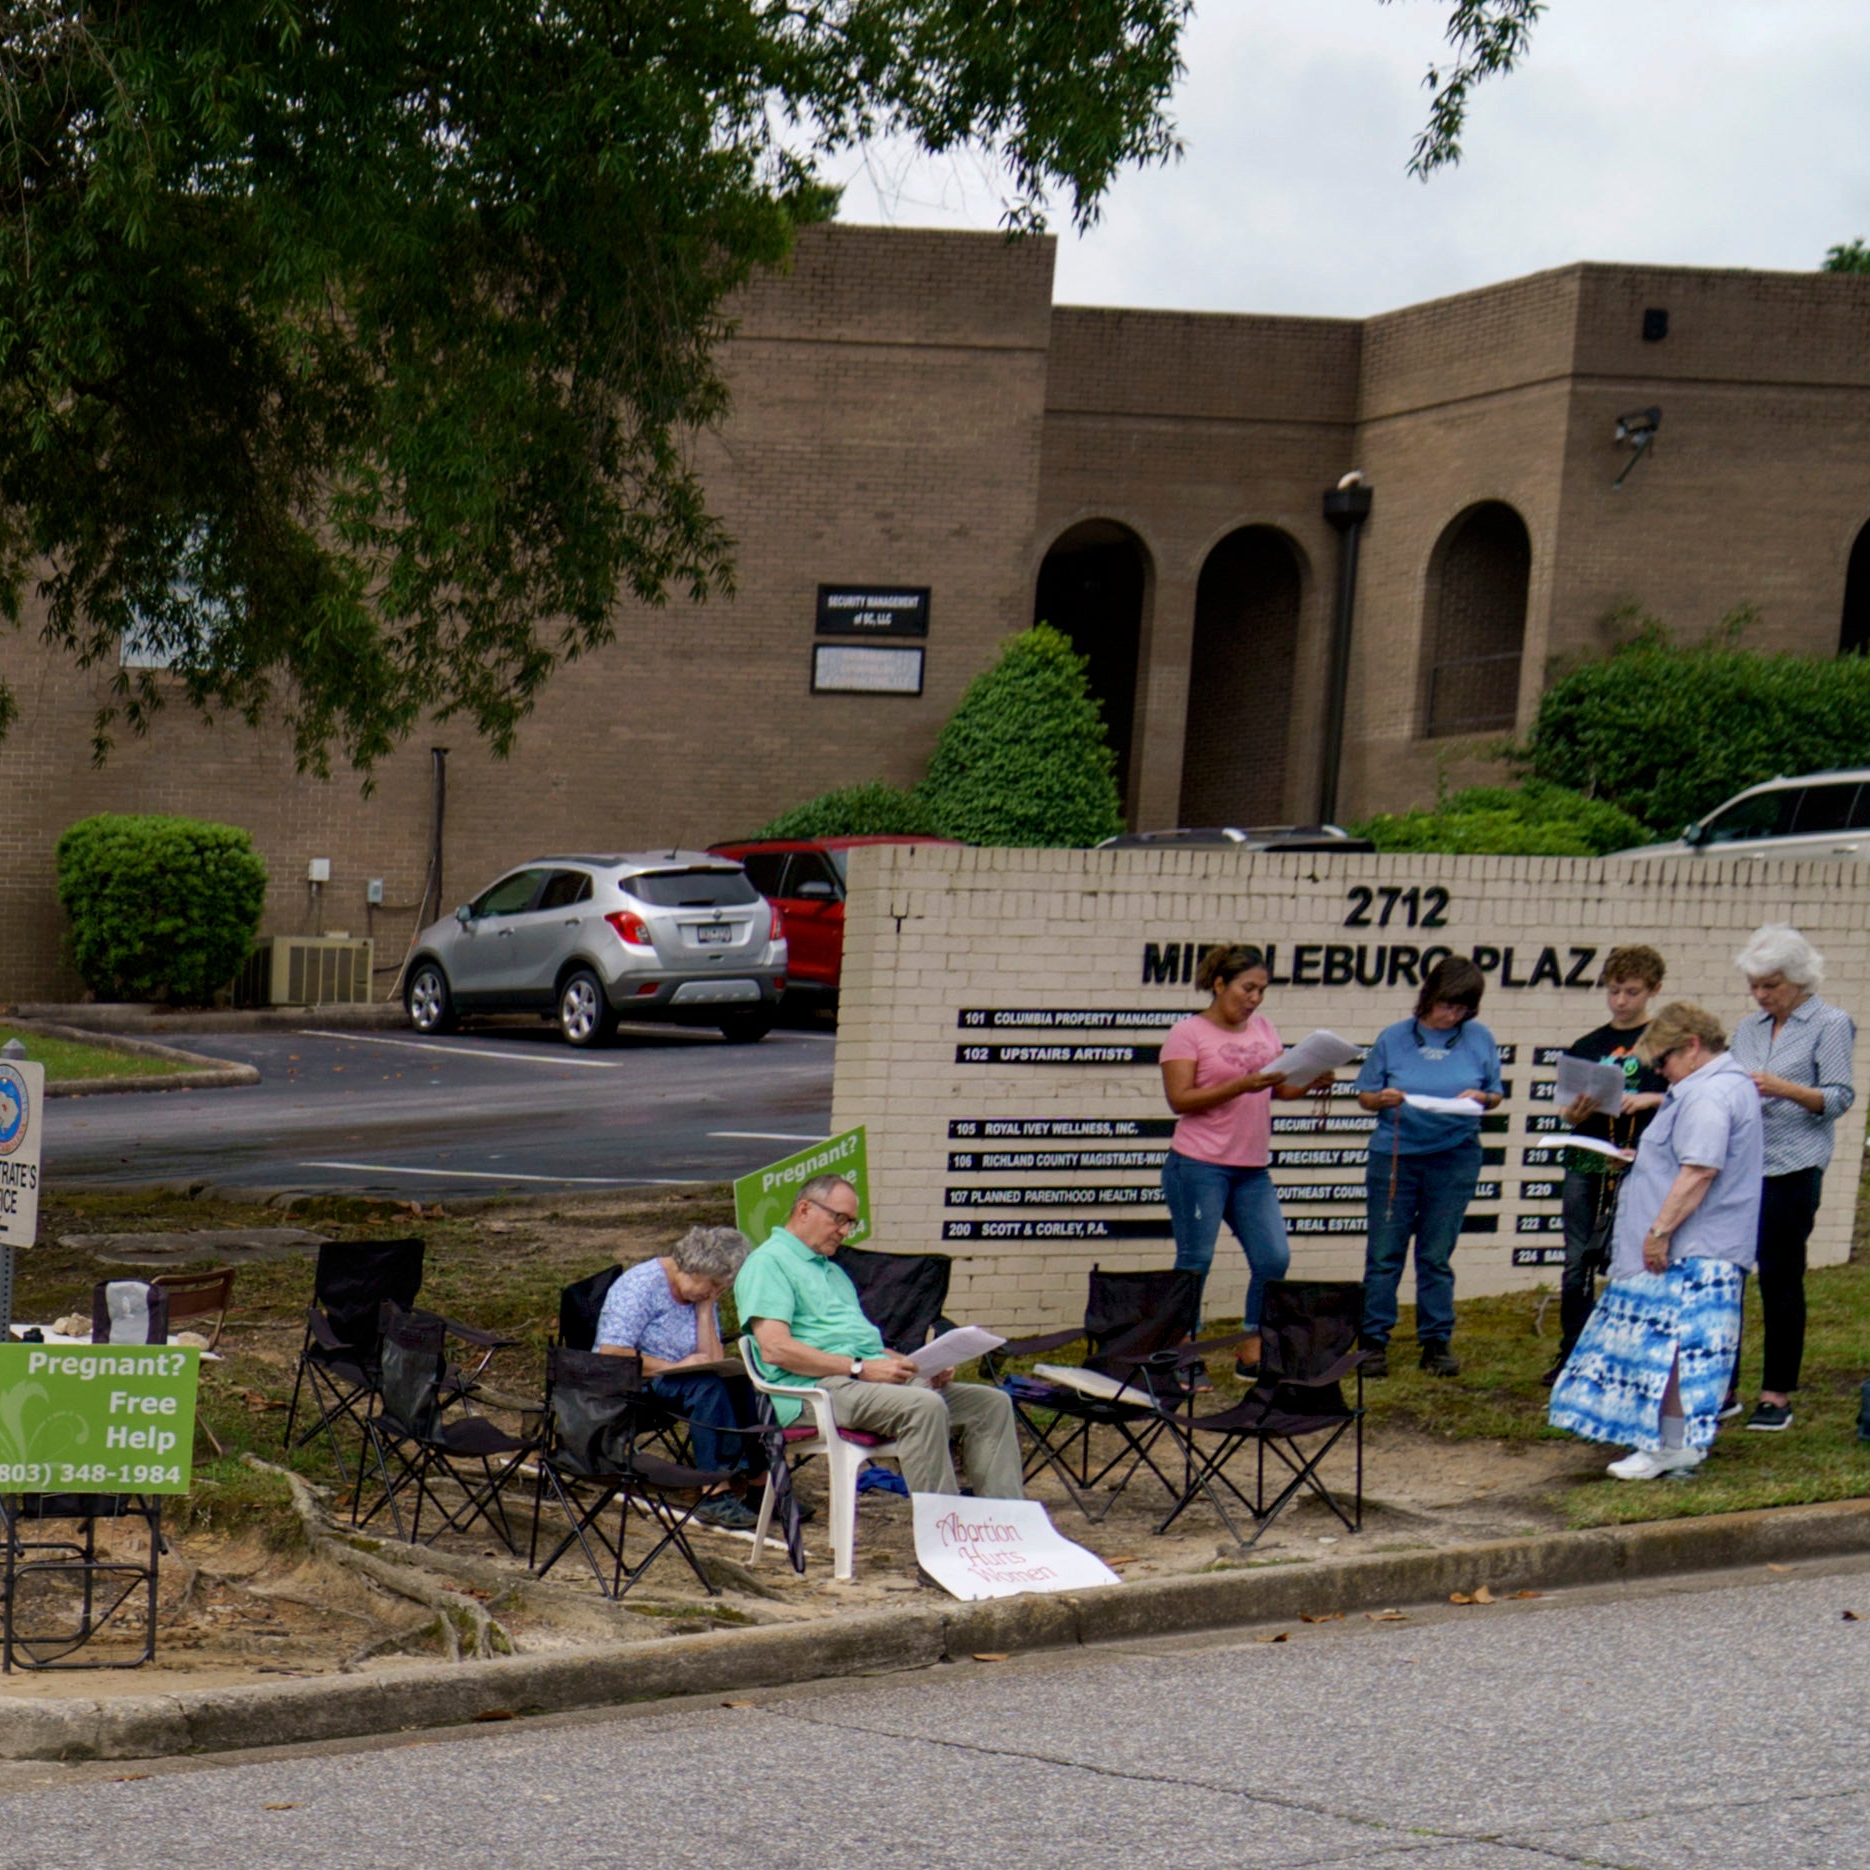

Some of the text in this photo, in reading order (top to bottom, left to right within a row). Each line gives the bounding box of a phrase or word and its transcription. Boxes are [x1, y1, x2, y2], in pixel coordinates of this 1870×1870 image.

[828, 594, 919, 609] SECURITY MANAGEMENT
[1343, 886, 1450, 928] 2712
[1471, 945, 1607, 988] PLAZ
[964, 1012, 986, 1026] 101
[993, 1012, 1053, 1026] COLUMBIA
[1054, 1012, 1114, 1026] PROPERTY
[963, 1047, 1134, 1061] 102 UPSTAIRS ARTISTS
[956, 1122, 1139, 1137] 105 ROYAL IVEY WELLNESS, INC.
[1536, 1117, 1556, 1130] 211
[762, 1134, 858, 1193] Pregnant?
[953, 1155, 972, 1168] 106
[982, 1153, 1035, 1168] RICHLAND
[1036, 1153, 1078, 1167] COUNTY
[1278, 1150, 1341, 1164] PRECISELY
[1527, 1149, 1548, 1162] 219
[949, 1190, 968, 1204] 107
[970, 1189, 1022, 1203] PLANNED
[1024, 1188, 1096, 1203] PARENTHOOD
[1098, 1188, 1138, 1202] HEALTH
[1275, 1186, 1332, 1200] OUTHEAST
[1526, 1184, 1552, 1197] 220
[948, 1222, 1109, 1238] 200 SCOTT & CORLEY, P.A.
[1295, 1219, 1327, 1232] REAL
[28, 1351, 186, 1381] Pregnant?
[109, 1391, 178, 1416] Free
[106, 1425, 177, 1455] Help
[60, 1464, 181, 1485] 348-1984
[936, 1511, 1024, 1547] Abortion
[958, 1541, 1027, 1568] Hurts
[967, 1566, 1058, 1584] Women
